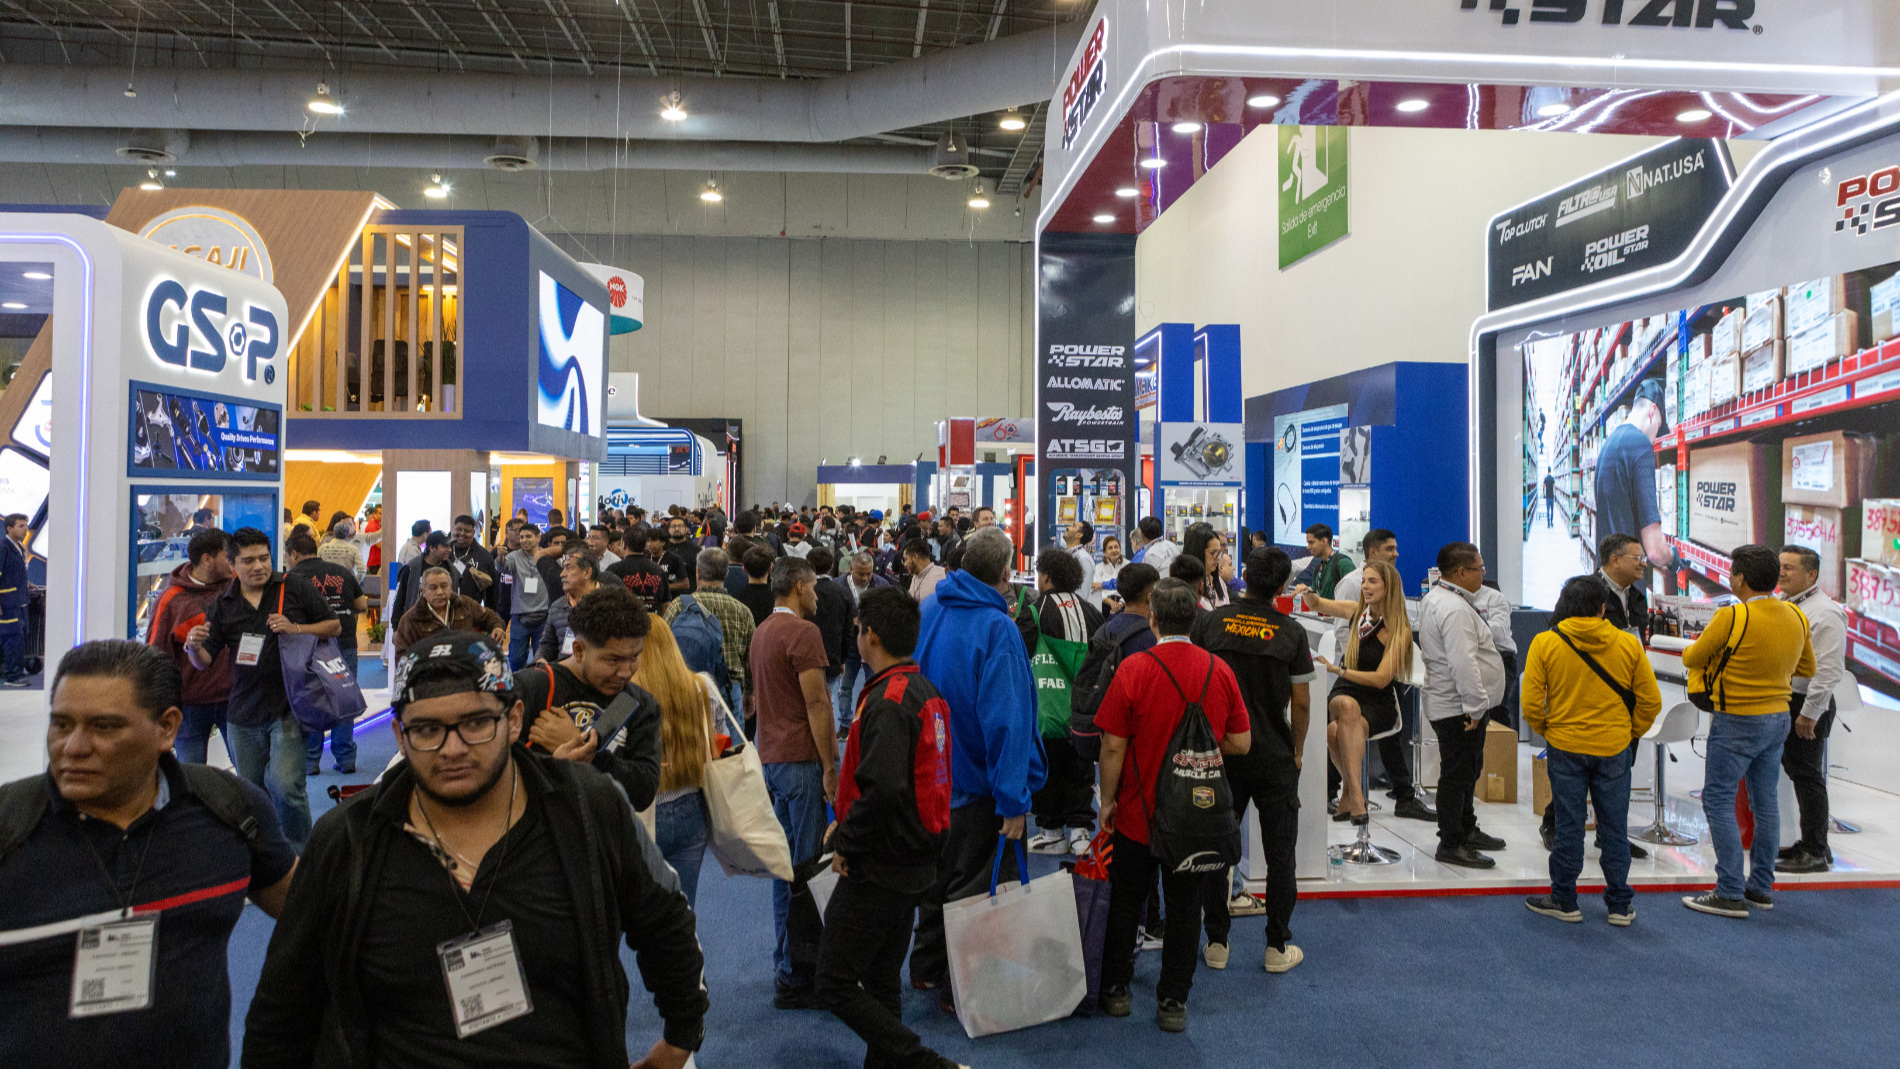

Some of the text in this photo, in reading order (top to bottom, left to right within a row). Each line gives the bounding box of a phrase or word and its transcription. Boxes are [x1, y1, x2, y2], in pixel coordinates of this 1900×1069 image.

[1063, 17, 1105, 121] POWER
[1066, 59, 1104, 142] STAR
[1643, 152, 1705, 189] NAT.USA
[1281, 184, 1346, 235] Salida de emergencia
[1307, 220, 1318, 239] Exit
[1496, 215, 1546, 245] TOP CLUTCH
[1585, 224, 1650, 258] POWER
[1593, 240, 1649, 270] OIL STAR
[1512, 257, 1553, 286] FAN
[609, 282, 625, 293] NGK
[1049, 344, 1126, 356] POWER
[1065, 355, 1124, 368] STAR
[1046, 375, 1122, 391] ALLOMATIC
[1046, 402, 1123, 426] Raybestos
[220, 431, 275, 446] Quality Driven Performance
[1046, 438, 1106, 453] ATSG
[1697, 481, 1737, 496] POWER
[1703, 495, 1736, 512] STAR
[1038, 677, 1066, 689] FAG
[1173, 767, 1207, 779] MUSCLE
